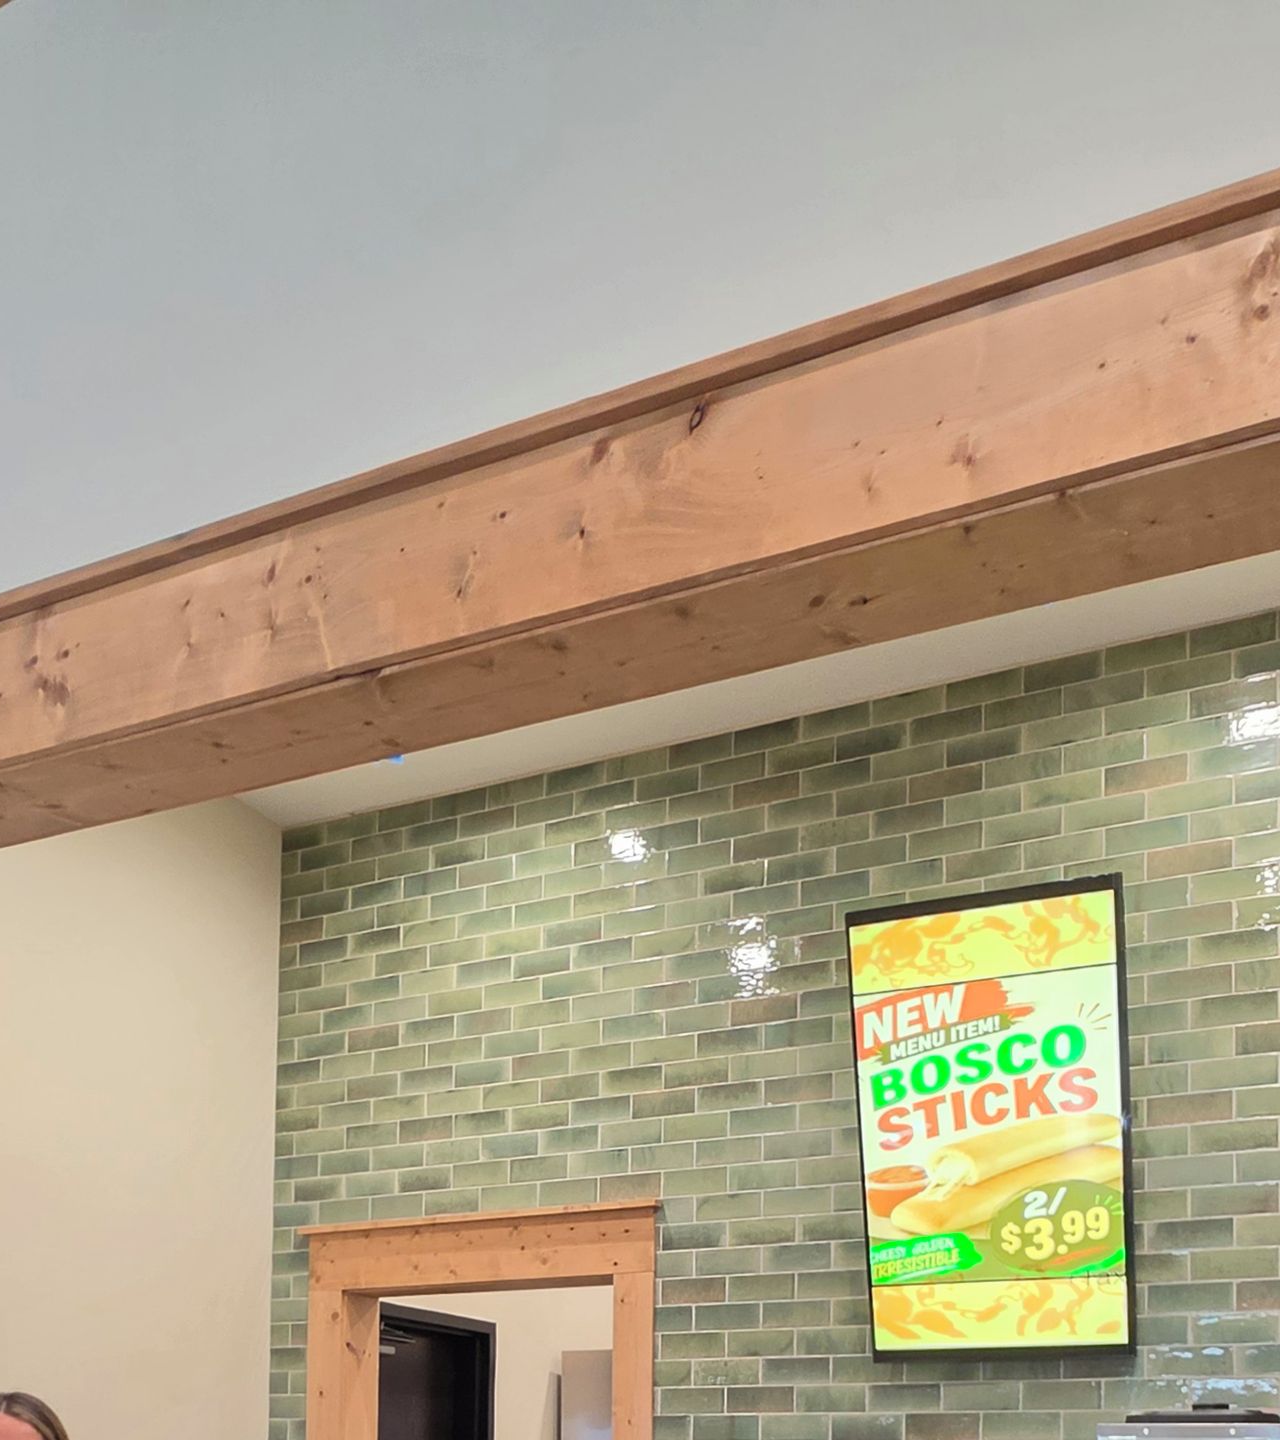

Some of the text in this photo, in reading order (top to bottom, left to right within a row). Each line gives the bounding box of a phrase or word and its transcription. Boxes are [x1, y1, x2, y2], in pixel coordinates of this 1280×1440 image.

[863, 983, 967, 1049] NEW
[890, 1015, 1001, 1061] MENU ITEM!
[870, 1024, 1086, 1111] BOSCO
[877, 1067, 1098, 1151] STICKS
[1023, 1187, 1067, 1219] 2/
[1000, 1206, 1110, 1260] $3.99
[872, 1248, 960, 1278] IRRESISTIBLE
